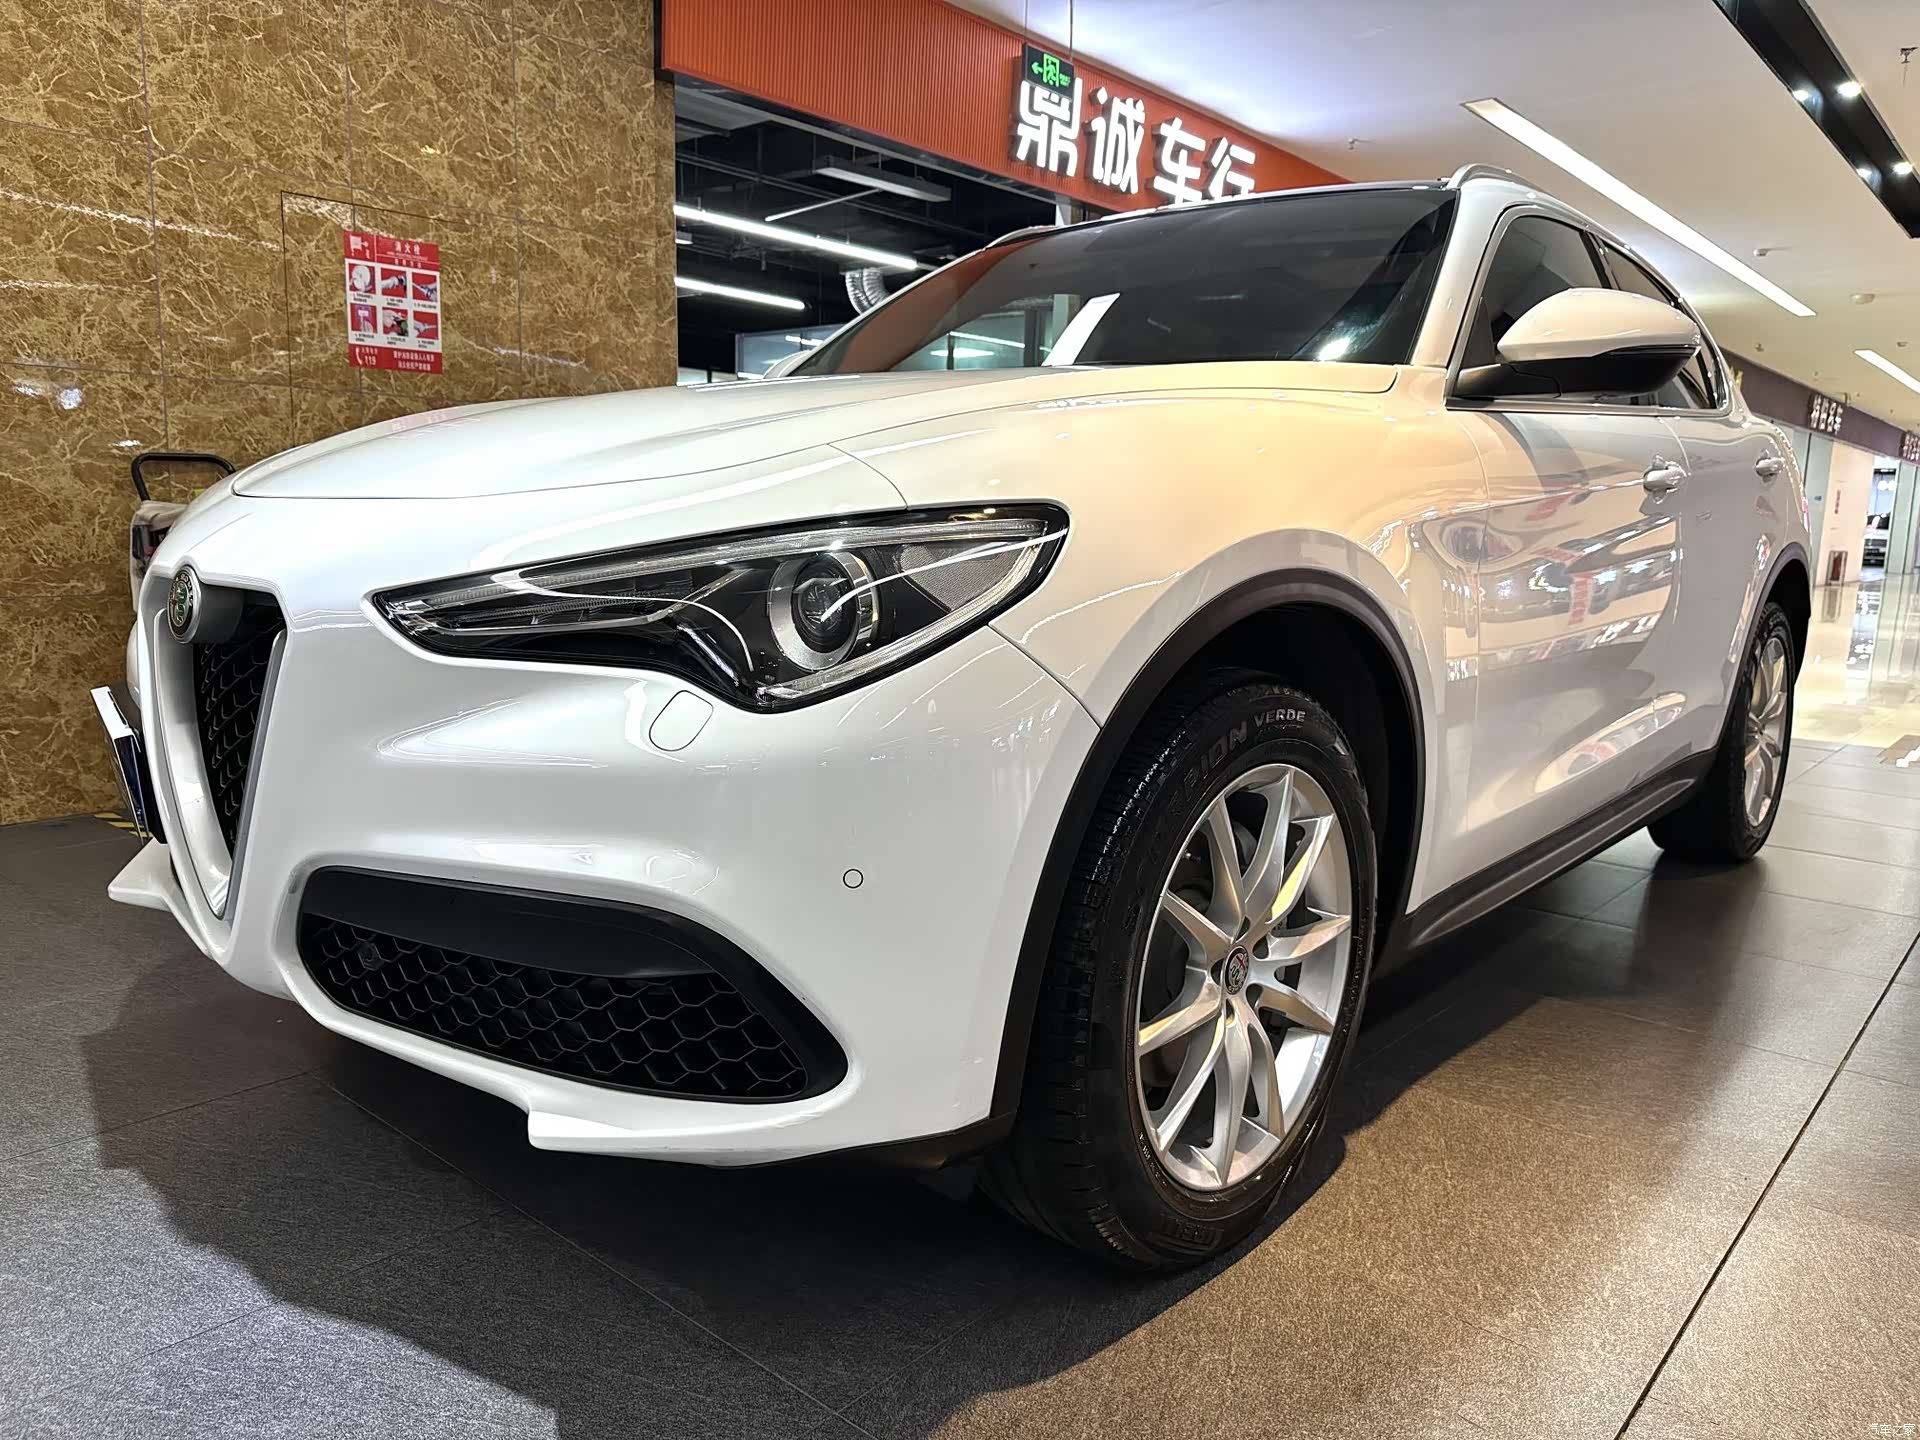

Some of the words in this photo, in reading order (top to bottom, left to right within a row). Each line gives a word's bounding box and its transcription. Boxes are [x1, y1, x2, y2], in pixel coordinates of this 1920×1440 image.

[1016, 77, 1256, 208] 鼎诚车行
[364, 355, 377, 366] 119
[1253, 708, 1306, 727] VERDE
